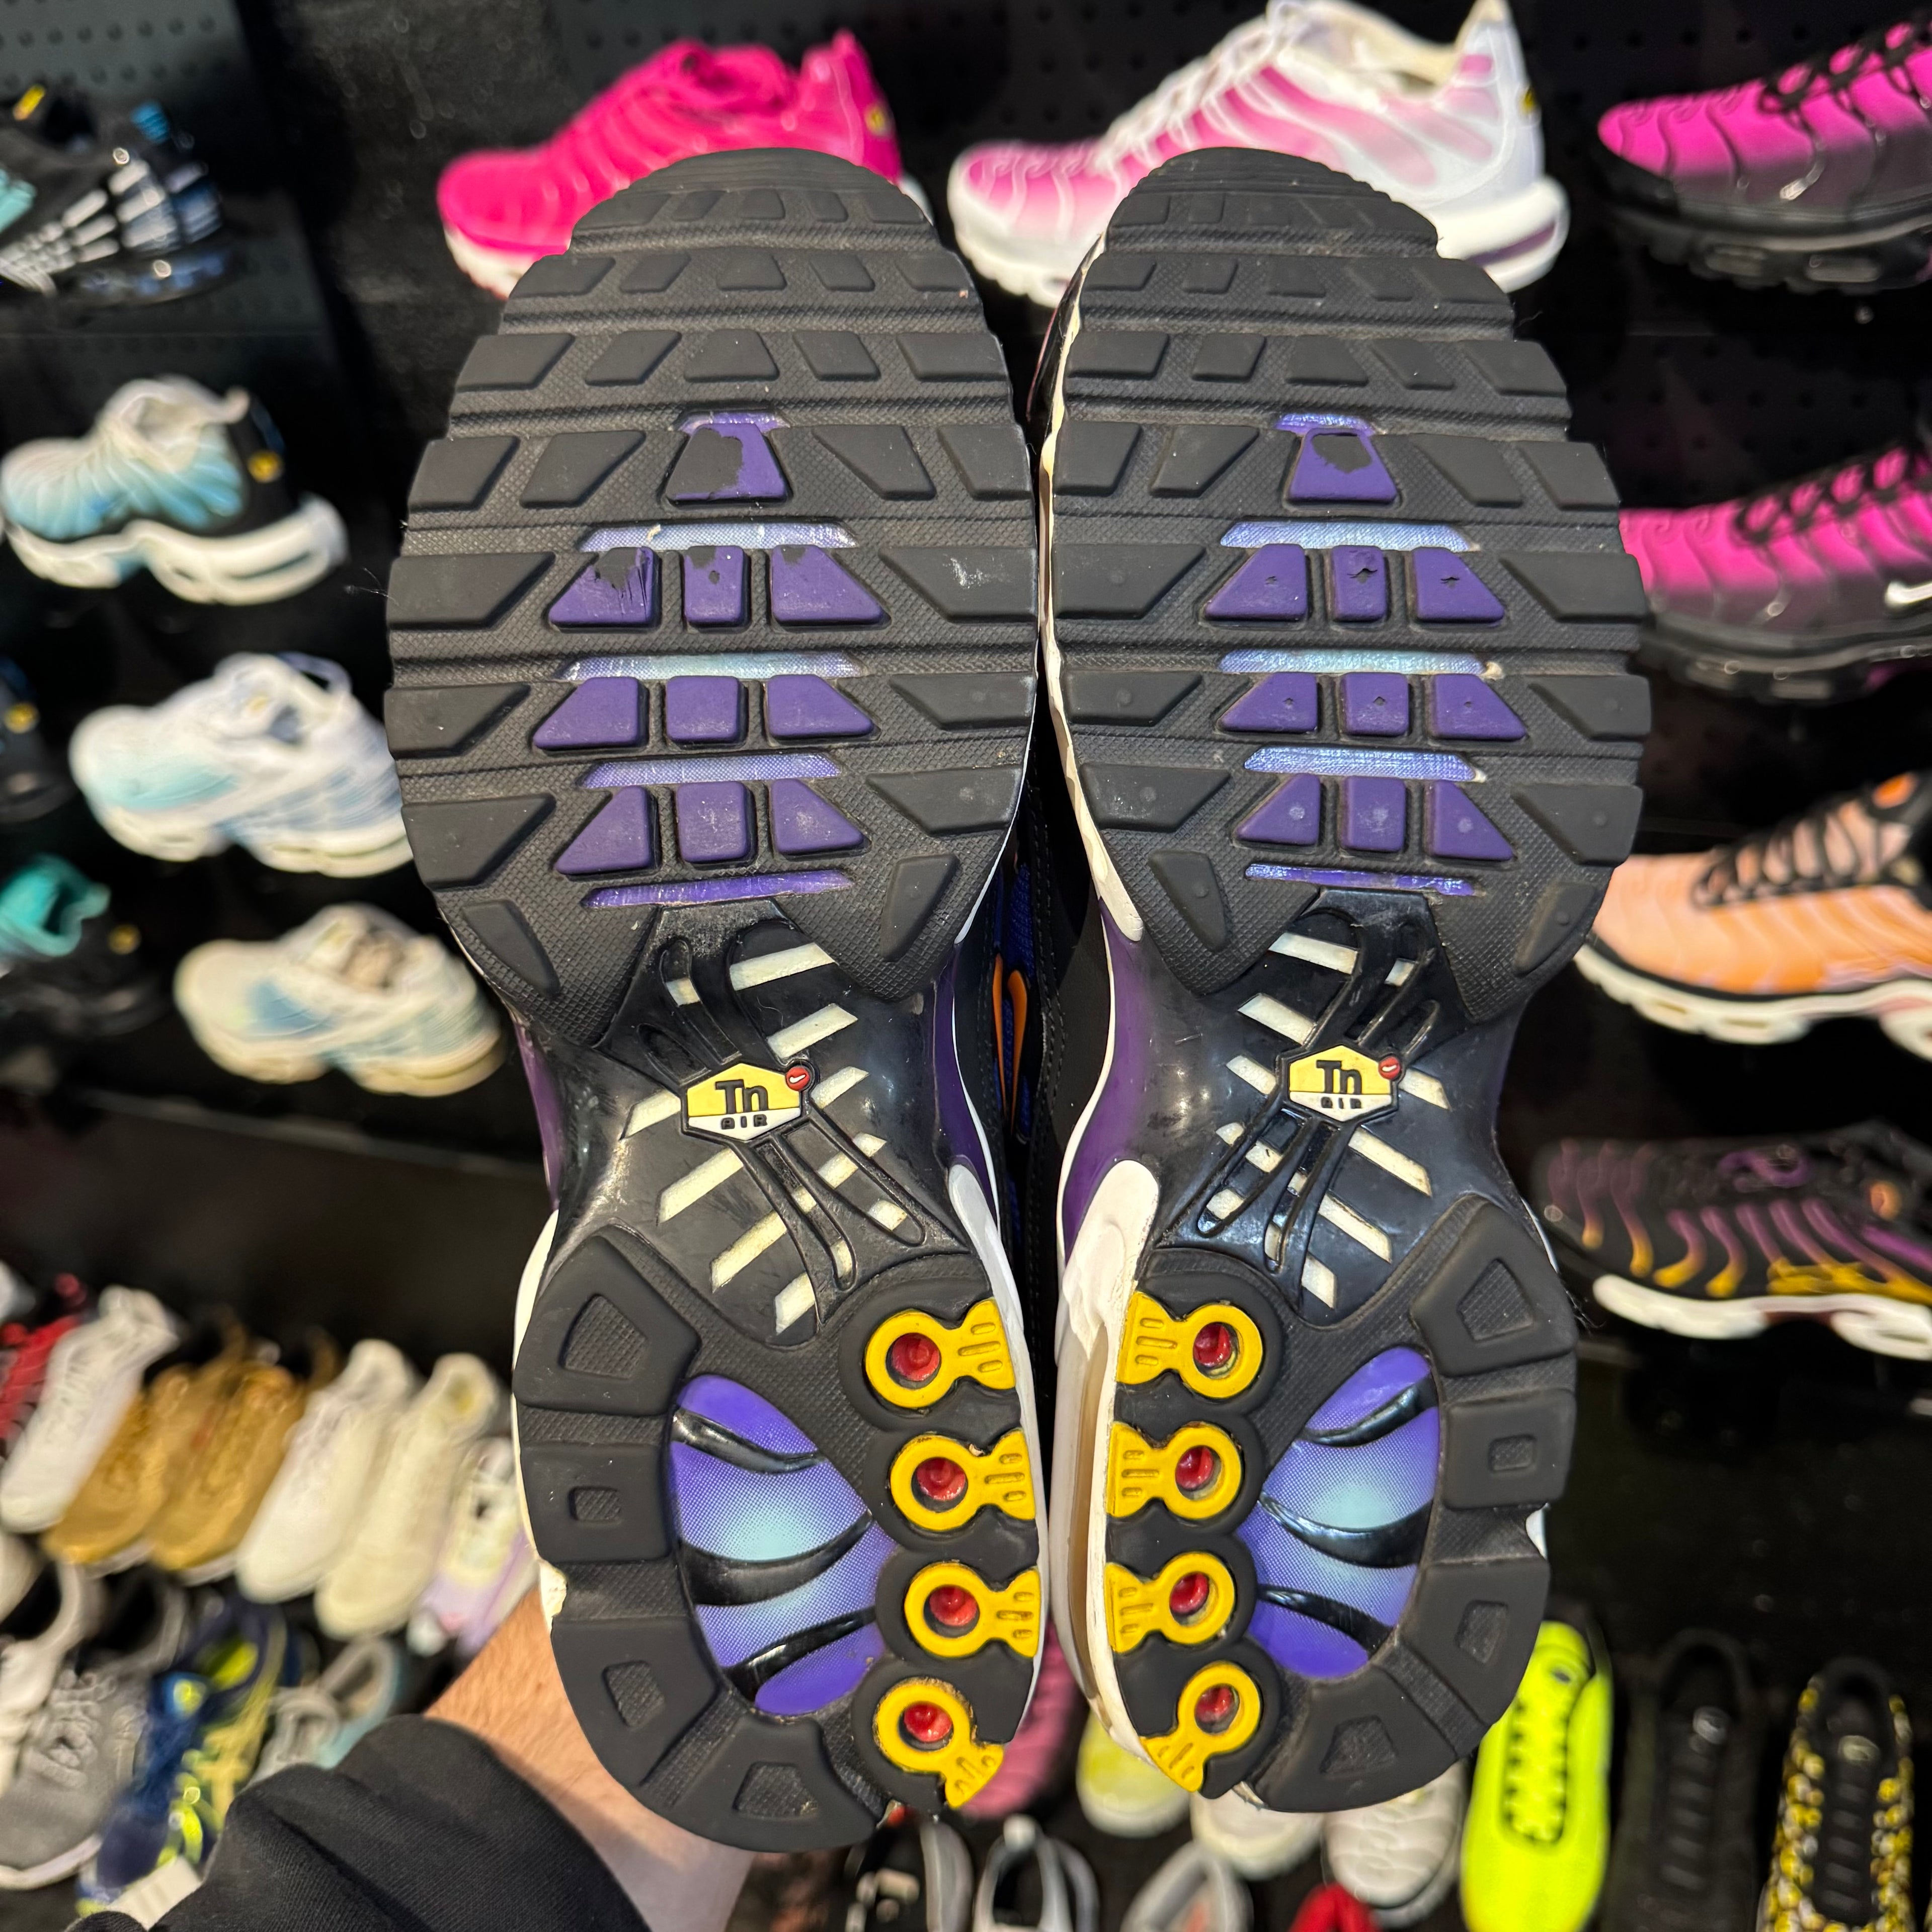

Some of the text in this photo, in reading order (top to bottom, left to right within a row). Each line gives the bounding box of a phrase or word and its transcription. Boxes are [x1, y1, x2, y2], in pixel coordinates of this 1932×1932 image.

[1317, 1060, 1362, 1095] Tn
[715, 1079, 768, 1114] Tn
[721, 1114, 767, 1129] AIR
